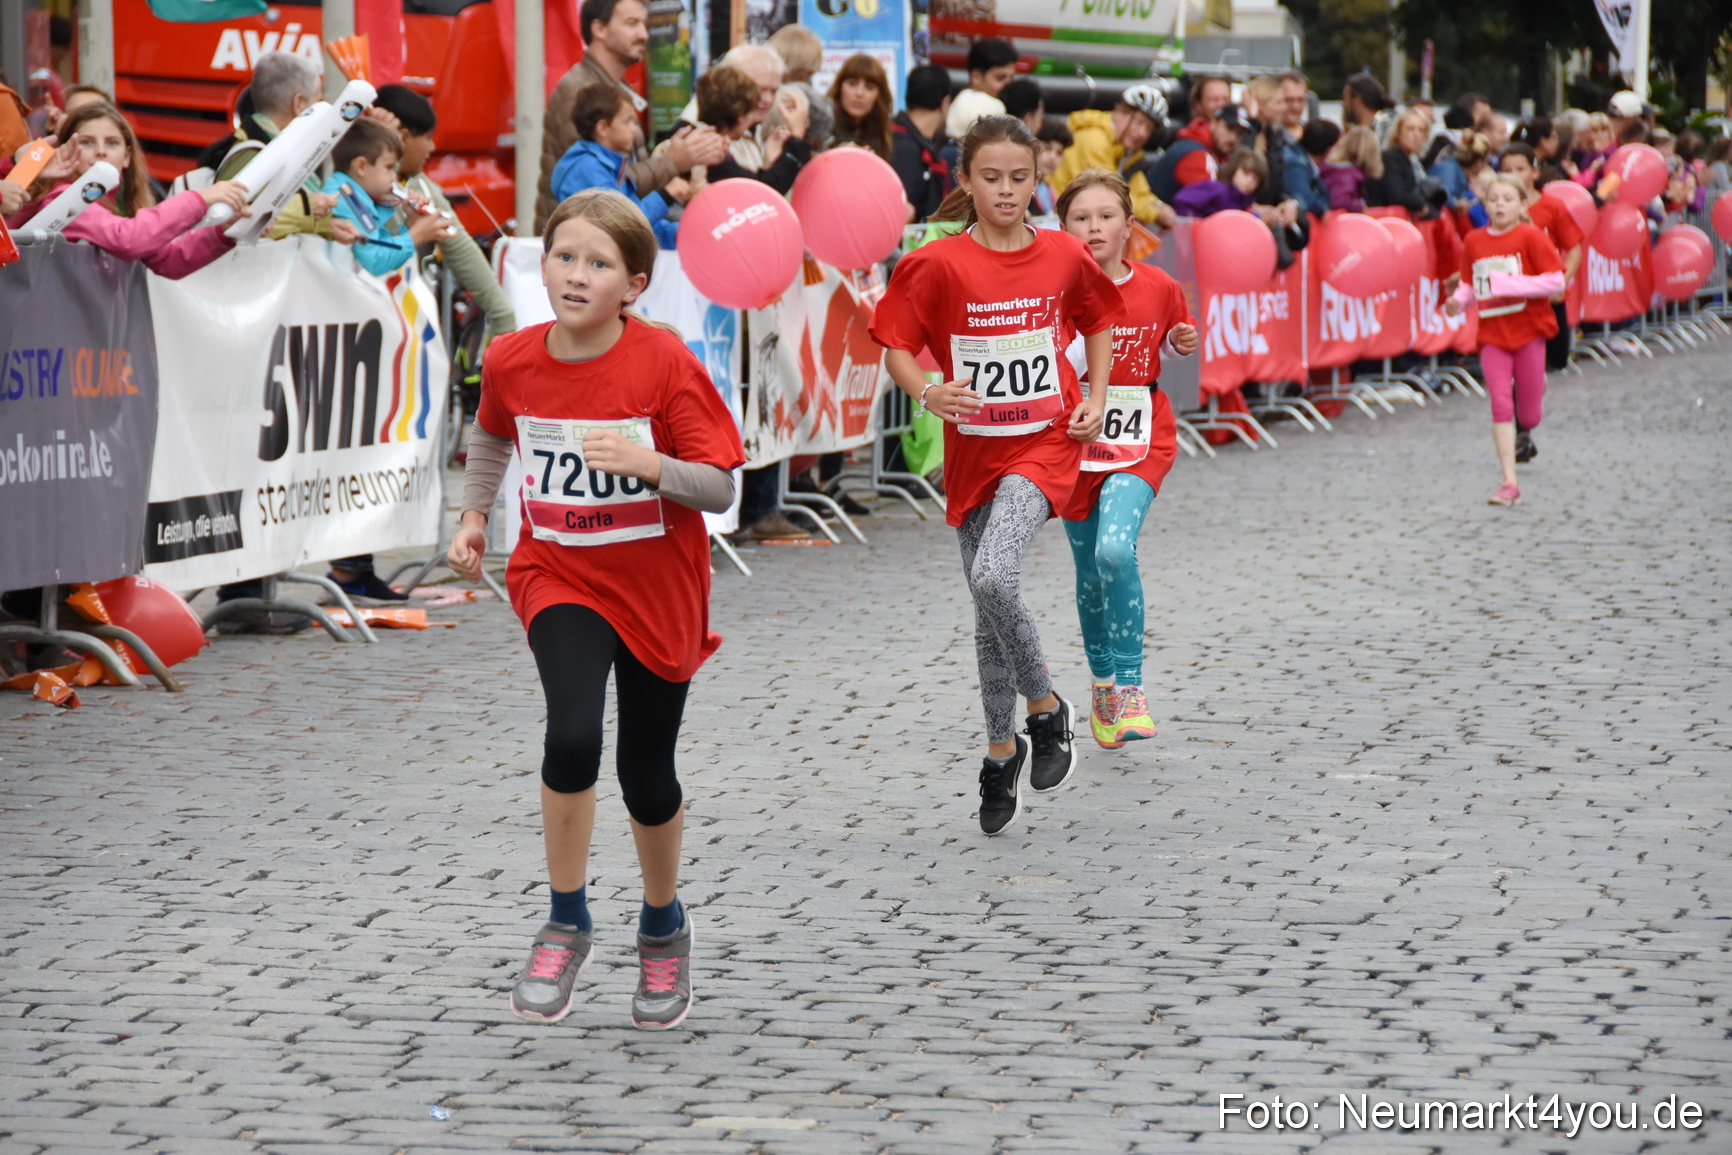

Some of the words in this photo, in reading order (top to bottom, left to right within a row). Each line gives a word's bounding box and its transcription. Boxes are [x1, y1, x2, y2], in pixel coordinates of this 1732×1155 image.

[966, 296, 1042, 314] Neumarkter
[967, 311, 1028, 328] Stadtlauf
[996, 332, 1049, 352] BOCK
[962, 355, 1051, 398] 7202
[990, 407, 1029, 423] Lucia
[527, 431, 565, 442] NeuerMarkt
[1087, 445, 1115, 461] Mira
[565, 510, 613, 529] Carla
